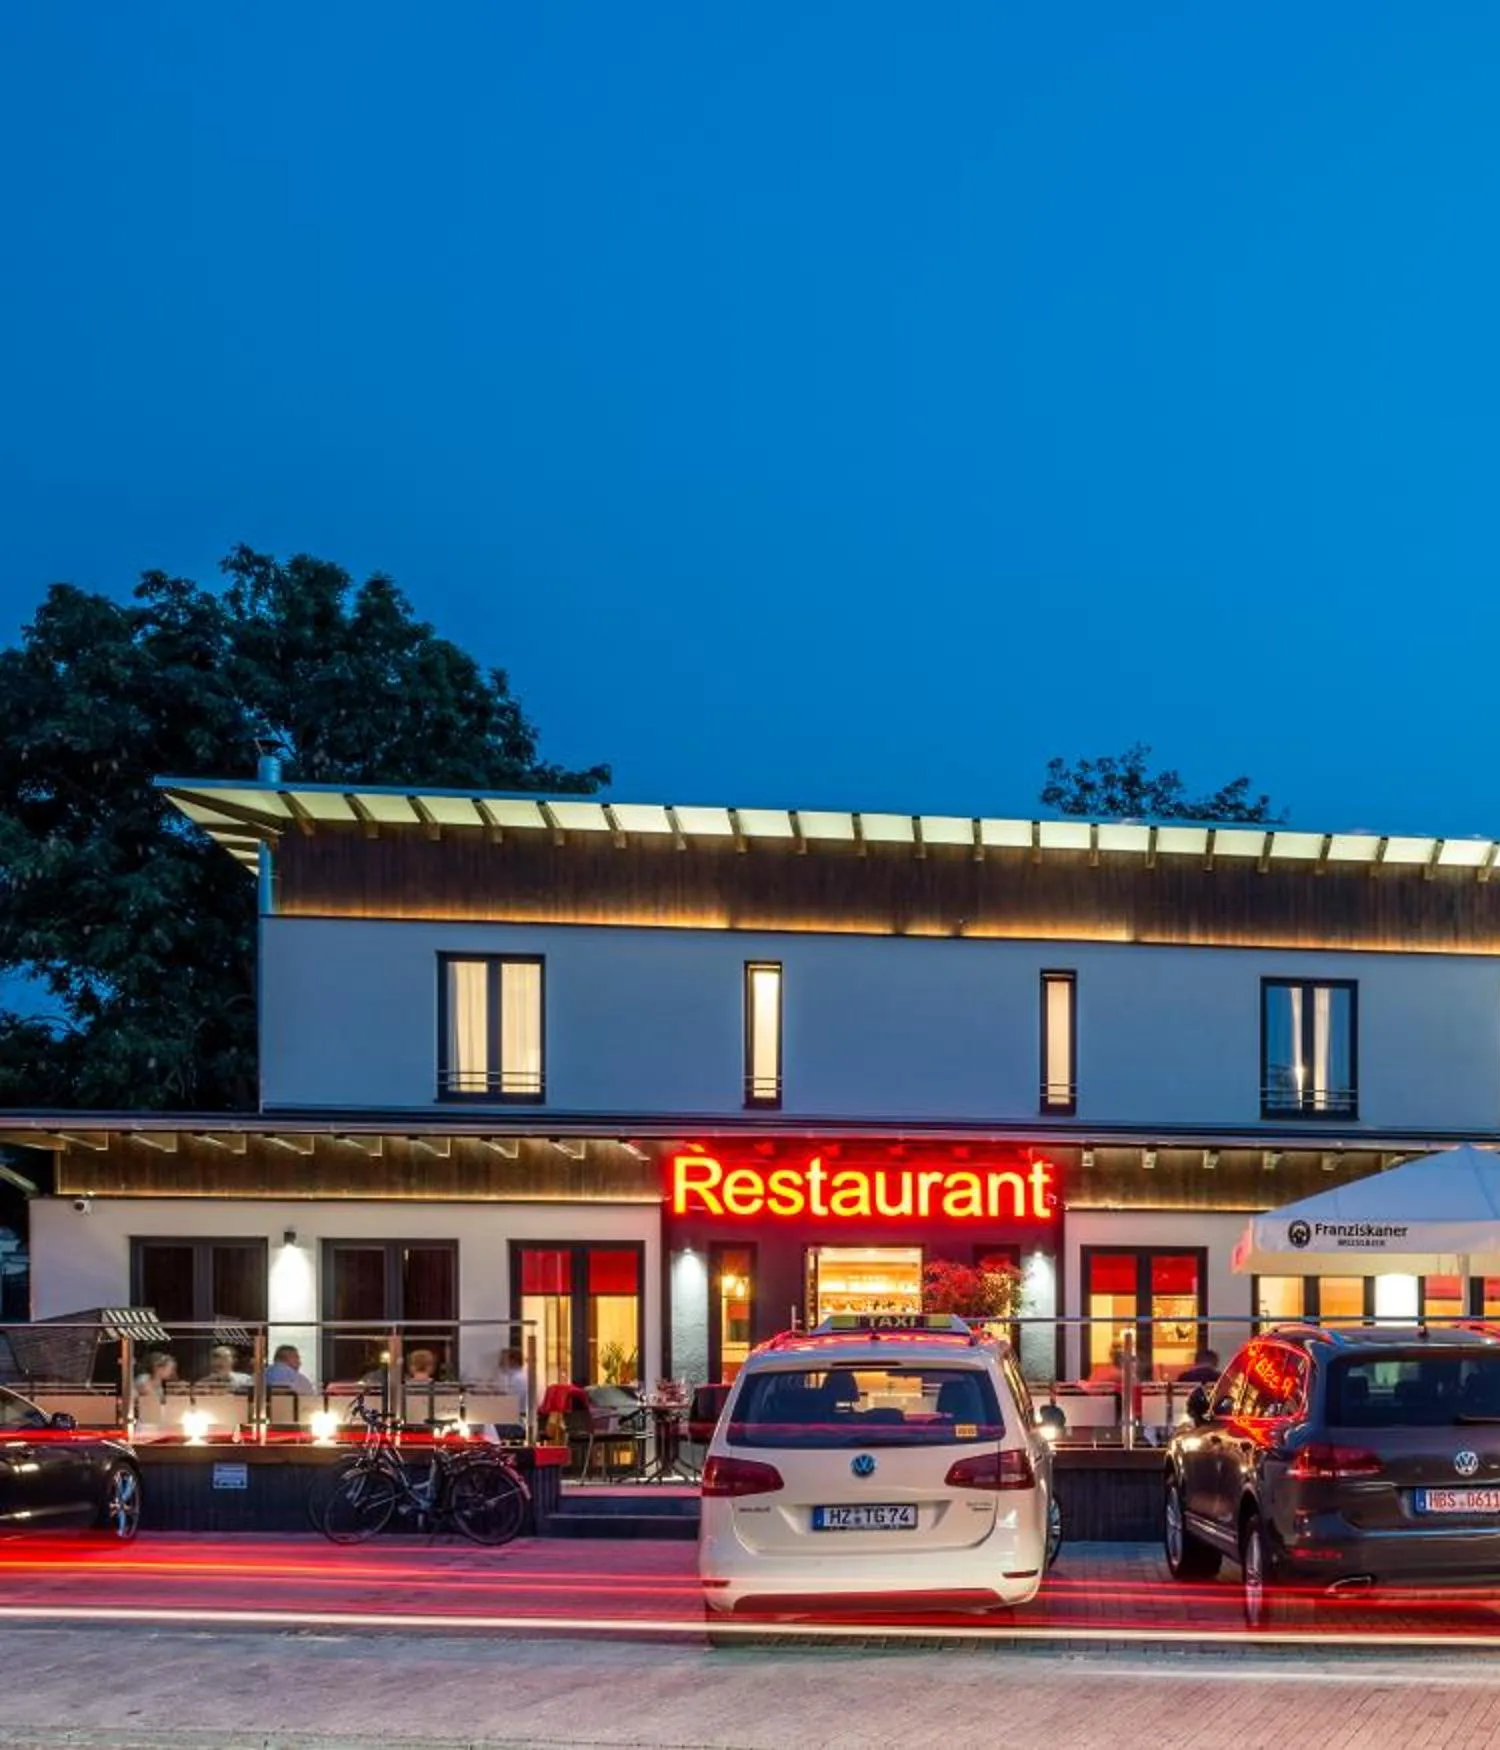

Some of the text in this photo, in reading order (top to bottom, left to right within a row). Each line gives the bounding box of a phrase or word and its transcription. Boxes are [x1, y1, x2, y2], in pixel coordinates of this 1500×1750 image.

[672, 1154, 1052, 1219] Restaurant
[1314, 1223, 1408, 1237] Franziskaner
[868, 1315, 916, 1328] TAXI
[829, 1508, 851, 1524] HZ
